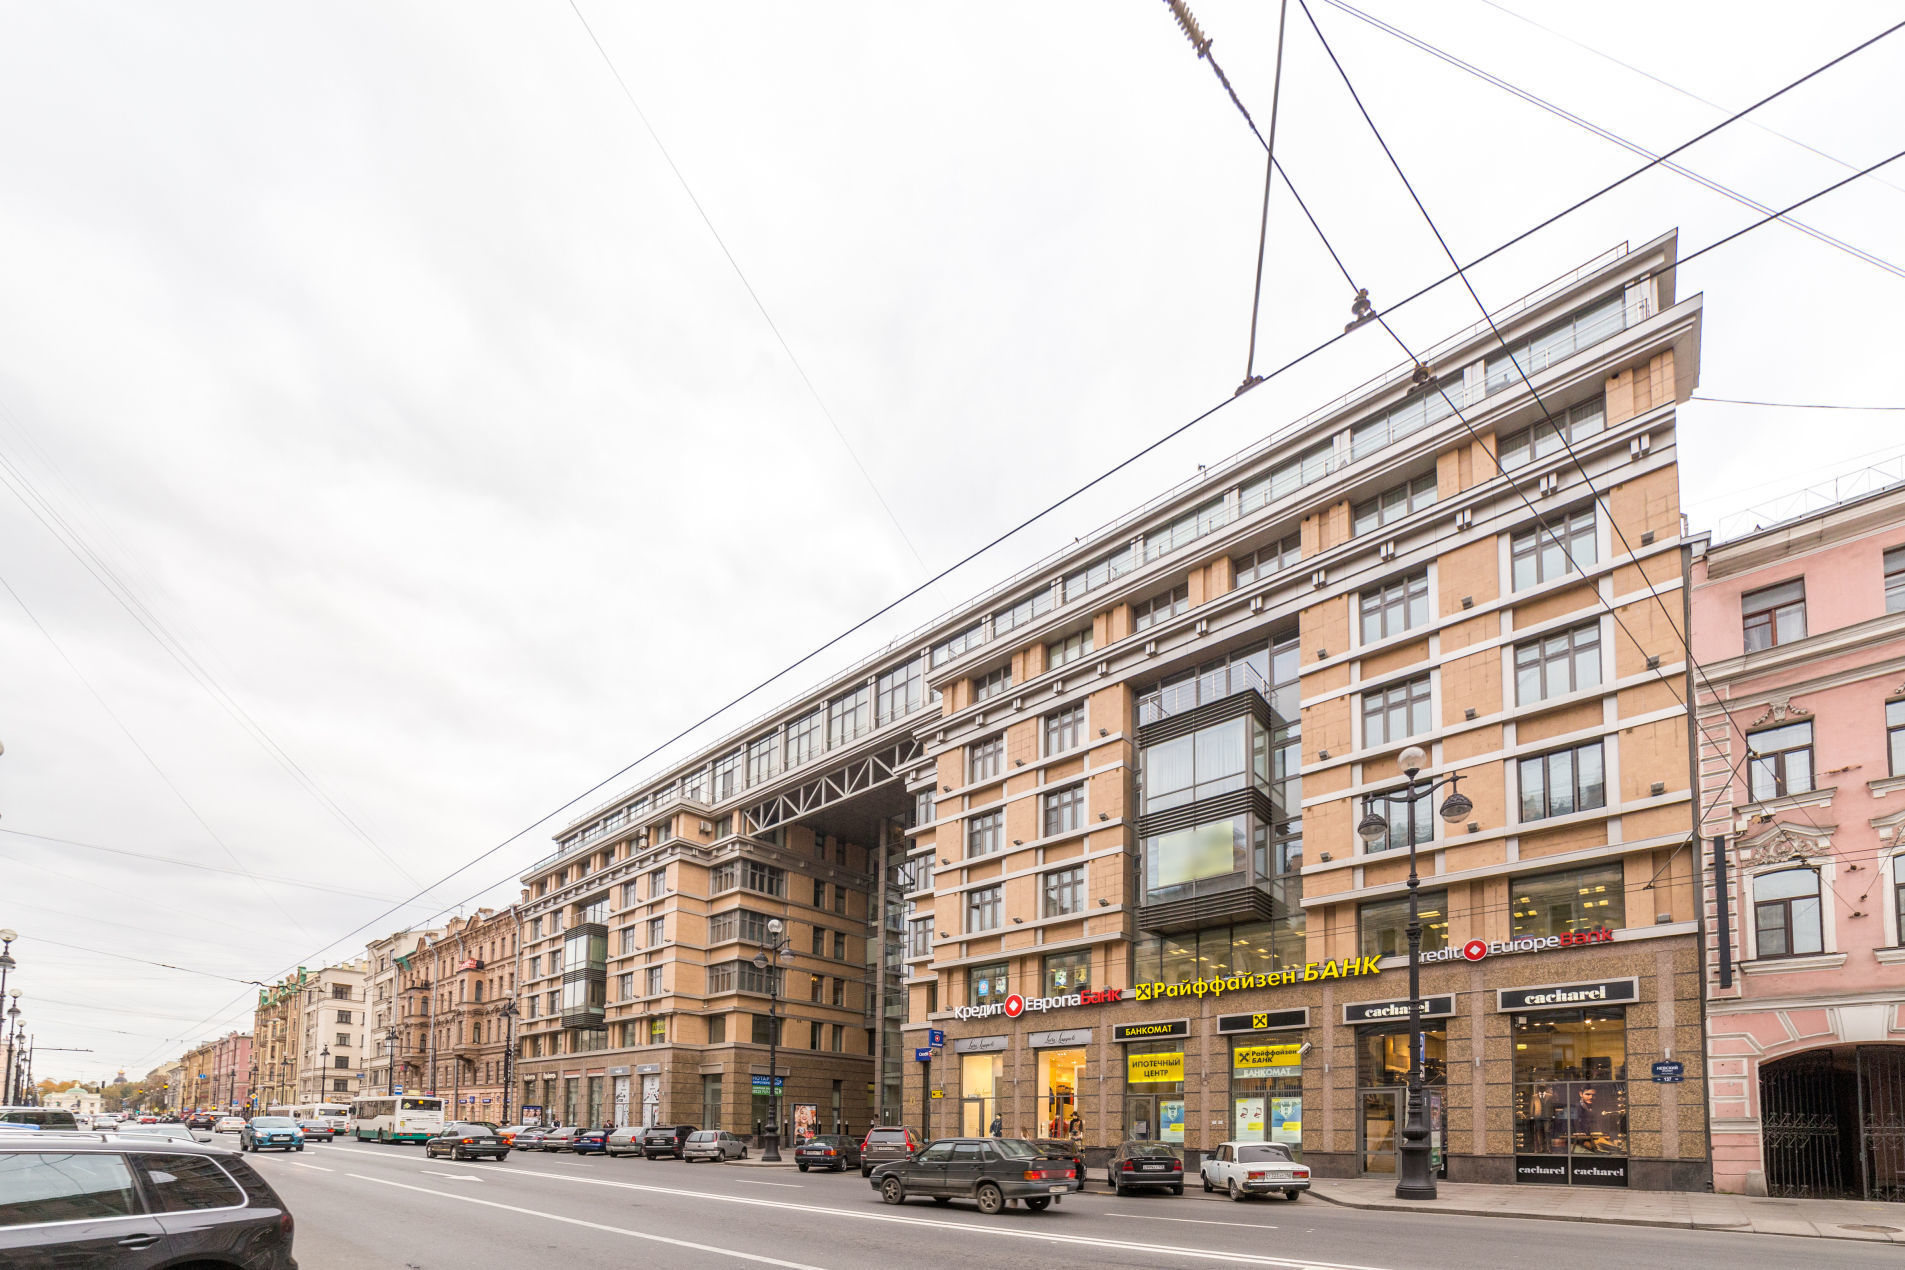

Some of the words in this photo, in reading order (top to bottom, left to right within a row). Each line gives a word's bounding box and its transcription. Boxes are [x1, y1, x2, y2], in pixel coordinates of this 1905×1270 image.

[1418, 945, 1462, 963] redit
[1154, 969, 1296, 1000] Райффайзен
[1303, 954, 1383, 982] БАНК
[1524, 986, 1606, 1005] cacharel
[954, 1003, 1004, 1021] Кредит
[1125, 1025, 1173, 1036] БАНКОМАТ
[1251, 1049, 1297, 1060] Райффайзен
[1132, 1058, 1181, 1068] ИПОТЕЧНЫЙ
[1143, 1070, 1169, 1078] ЦЕНТР
[1243, 1067, 1291, 1076] БАНКОМАТ
[1518, 1165, 1565, 1176] cacharel
[1573, 1166, 1624, 1177] cacharel
